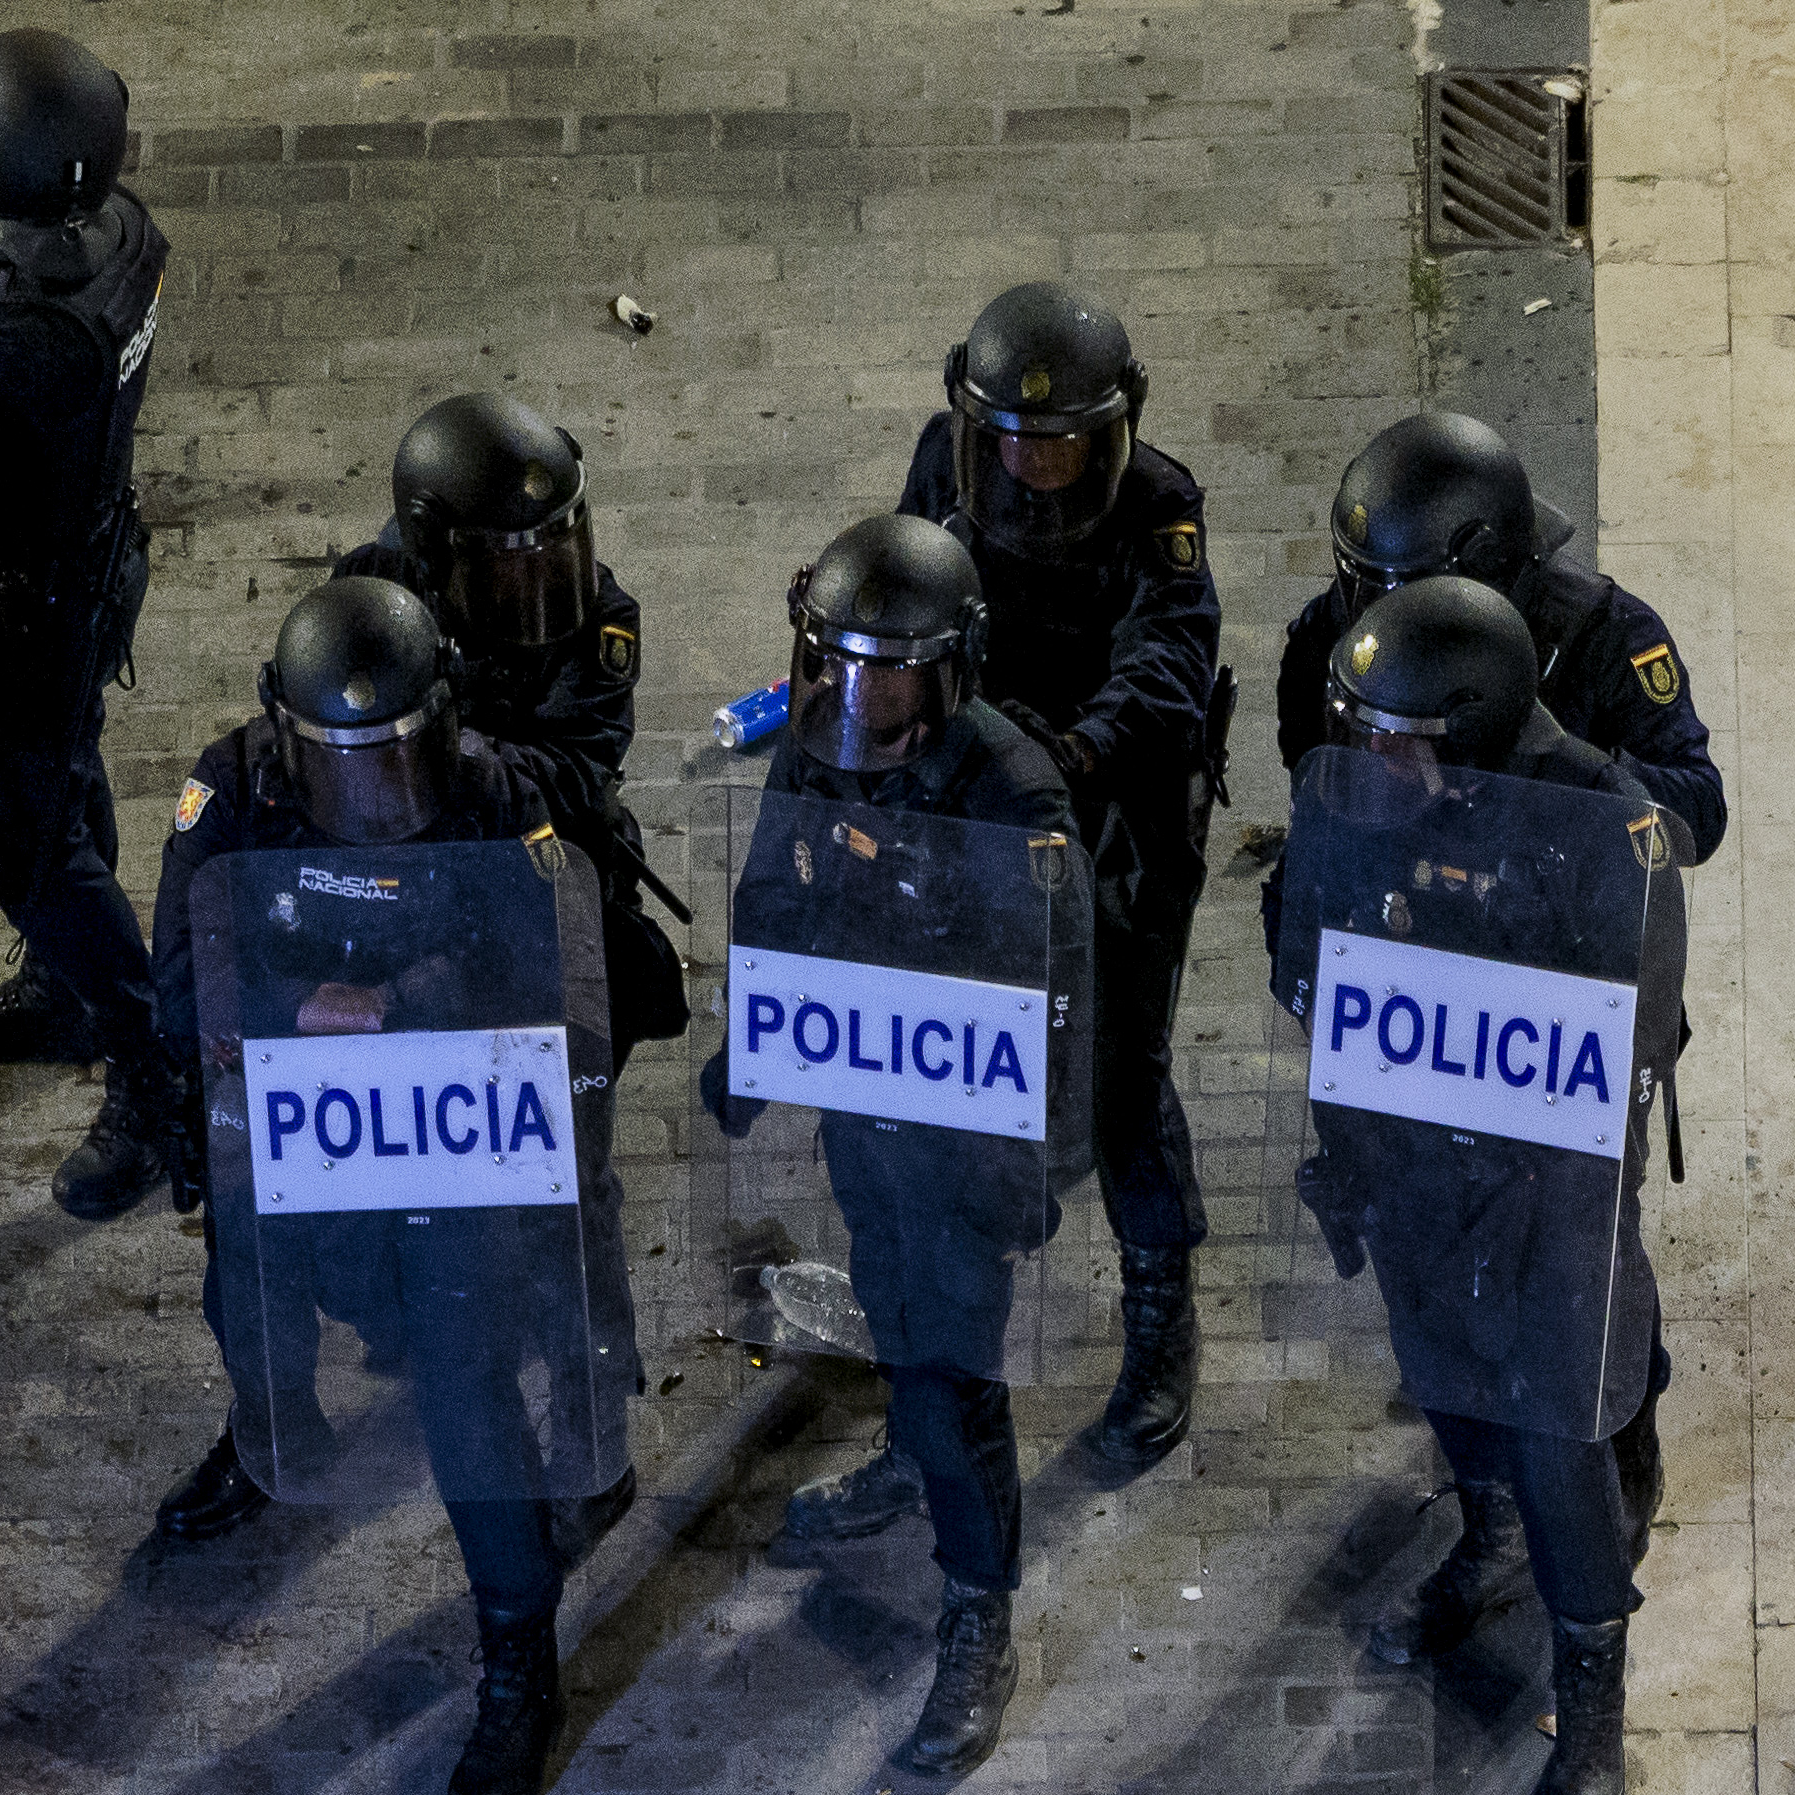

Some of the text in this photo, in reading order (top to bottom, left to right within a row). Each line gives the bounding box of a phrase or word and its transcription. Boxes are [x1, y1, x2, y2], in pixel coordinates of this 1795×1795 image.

[298, 877, 399, 901] NACIONAL
[300, 866, 379, 890] POLICIA
[747, 993, 1030, 1094] POLICIA
[1331, 983, 1611, 1104] POLICIA
[266, 1080, 558, 1162] POLICIA
